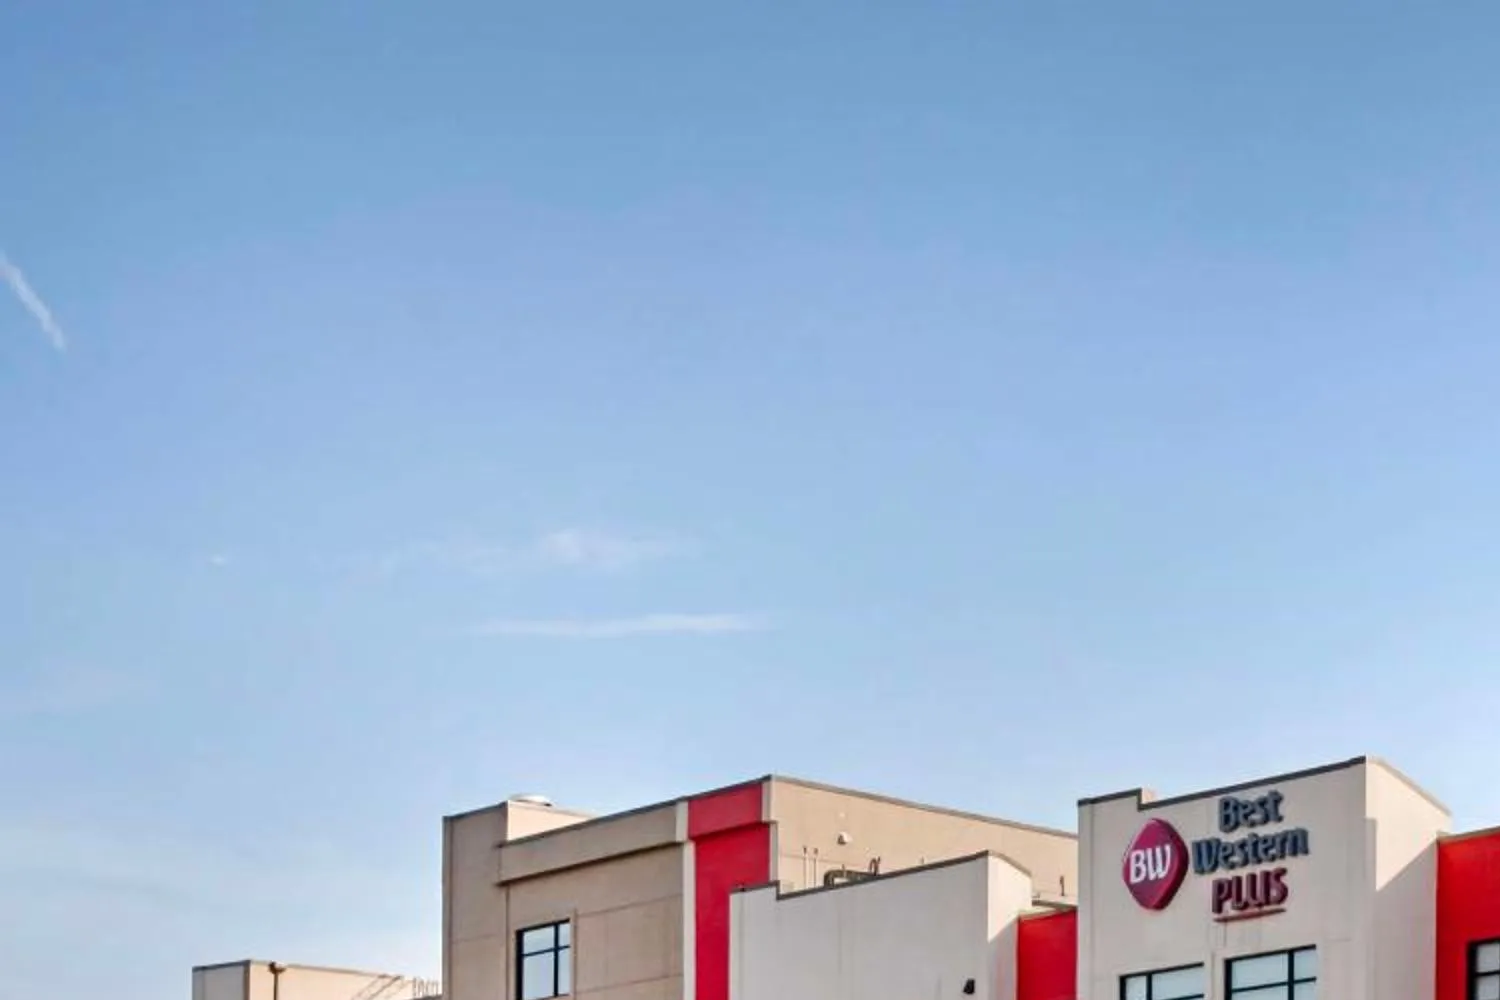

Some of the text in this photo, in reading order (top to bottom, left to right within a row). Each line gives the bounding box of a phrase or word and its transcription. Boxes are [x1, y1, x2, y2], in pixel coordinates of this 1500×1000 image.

[1219, 790, 1284, 833] Best
[1129, 845, 1171, 883] BW
[1191, 827, 1311, 875] Western
[1211, 867, 1289, 914] PLUS
